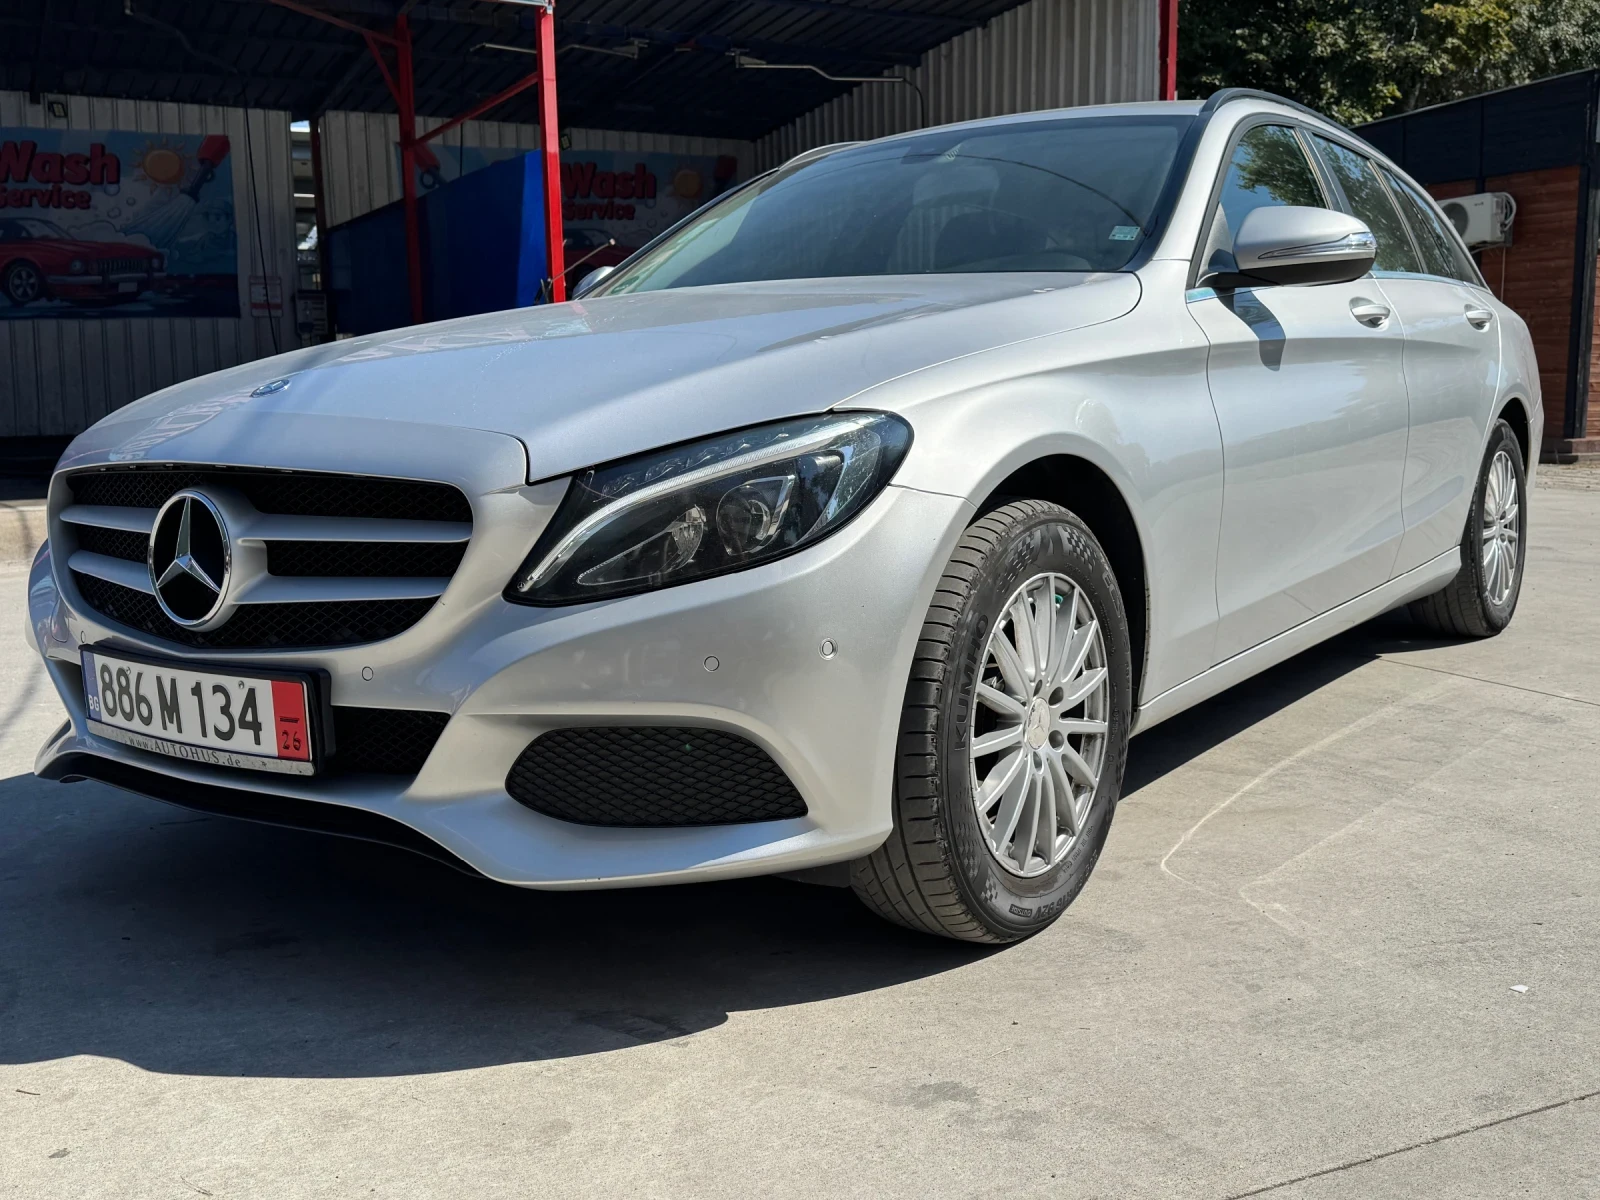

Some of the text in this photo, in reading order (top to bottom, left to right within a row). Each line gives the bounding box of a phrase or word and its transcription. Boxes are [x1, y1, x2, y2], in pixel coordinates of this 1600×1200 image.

[0, 140, 121, 185] Wash
[560, 161, 657, 199] Wash
[954, 614, 989, 751] KUMHO
[88, 694, 100, 712] BG
[100, 663, 262, 746] 886 M 134
[128, 736, 241, 767] www.AUTOHUS.de
[281, 729, 302, 752] 26
